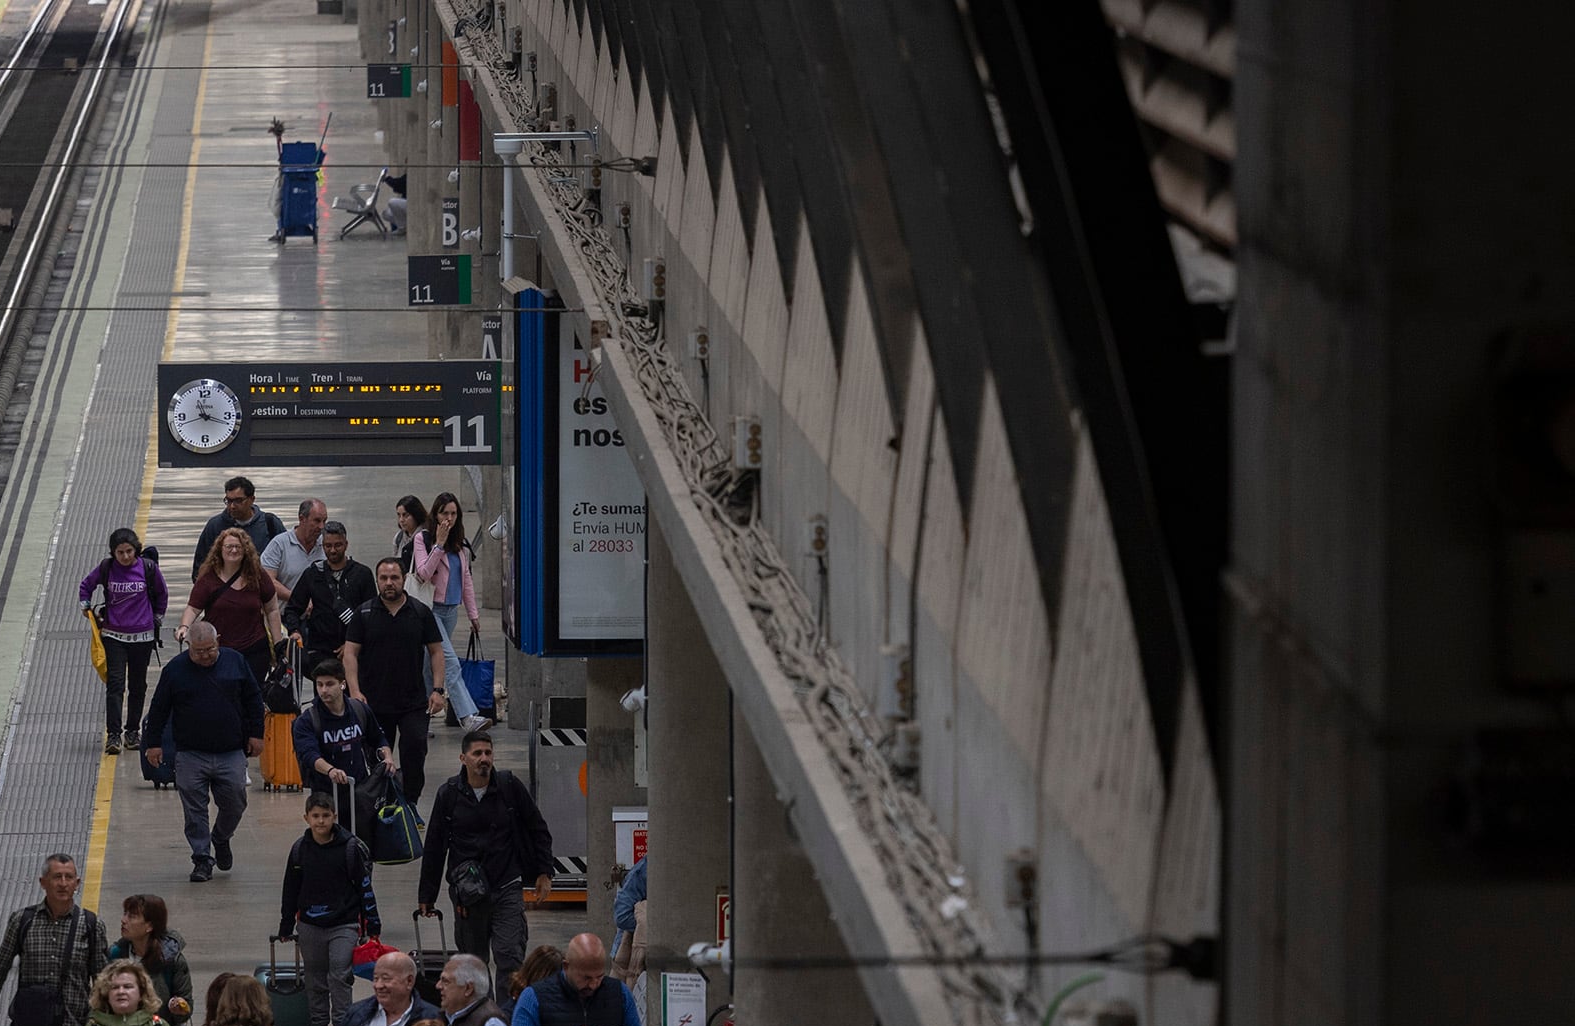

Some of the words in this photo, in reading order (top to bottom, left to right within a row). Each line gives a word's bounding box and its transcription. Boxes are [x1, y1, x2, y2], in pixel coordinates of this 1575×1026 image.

[369, 83, 385, 97] 11
[442, 213, 458, 246] B
[412, 285, 434, 303] 11
[249, 374, 273, 383] Hora
[312, 373, 333, 383] Tren
[476, 371, 492, 381] Vía
[198, 390, 211, 399] 12
[251, 405, 288, 416] estino
[300, 408, 337, 416] DESTINATION
[573, 396, 608, 415] es
[178, 413, 186, 421] 9
[224, 411, 232, 420] 3
[201, 434, 210, 444] 6
[444, 415, 492, 453] 11
[572, 502, 597, 515] ¿Te
[573, 521, 609, 534] Envía
[572, 539, 584, 552] al
[588, 540, 634, 552] 28033
[323, 723, 363, 744] NASA
